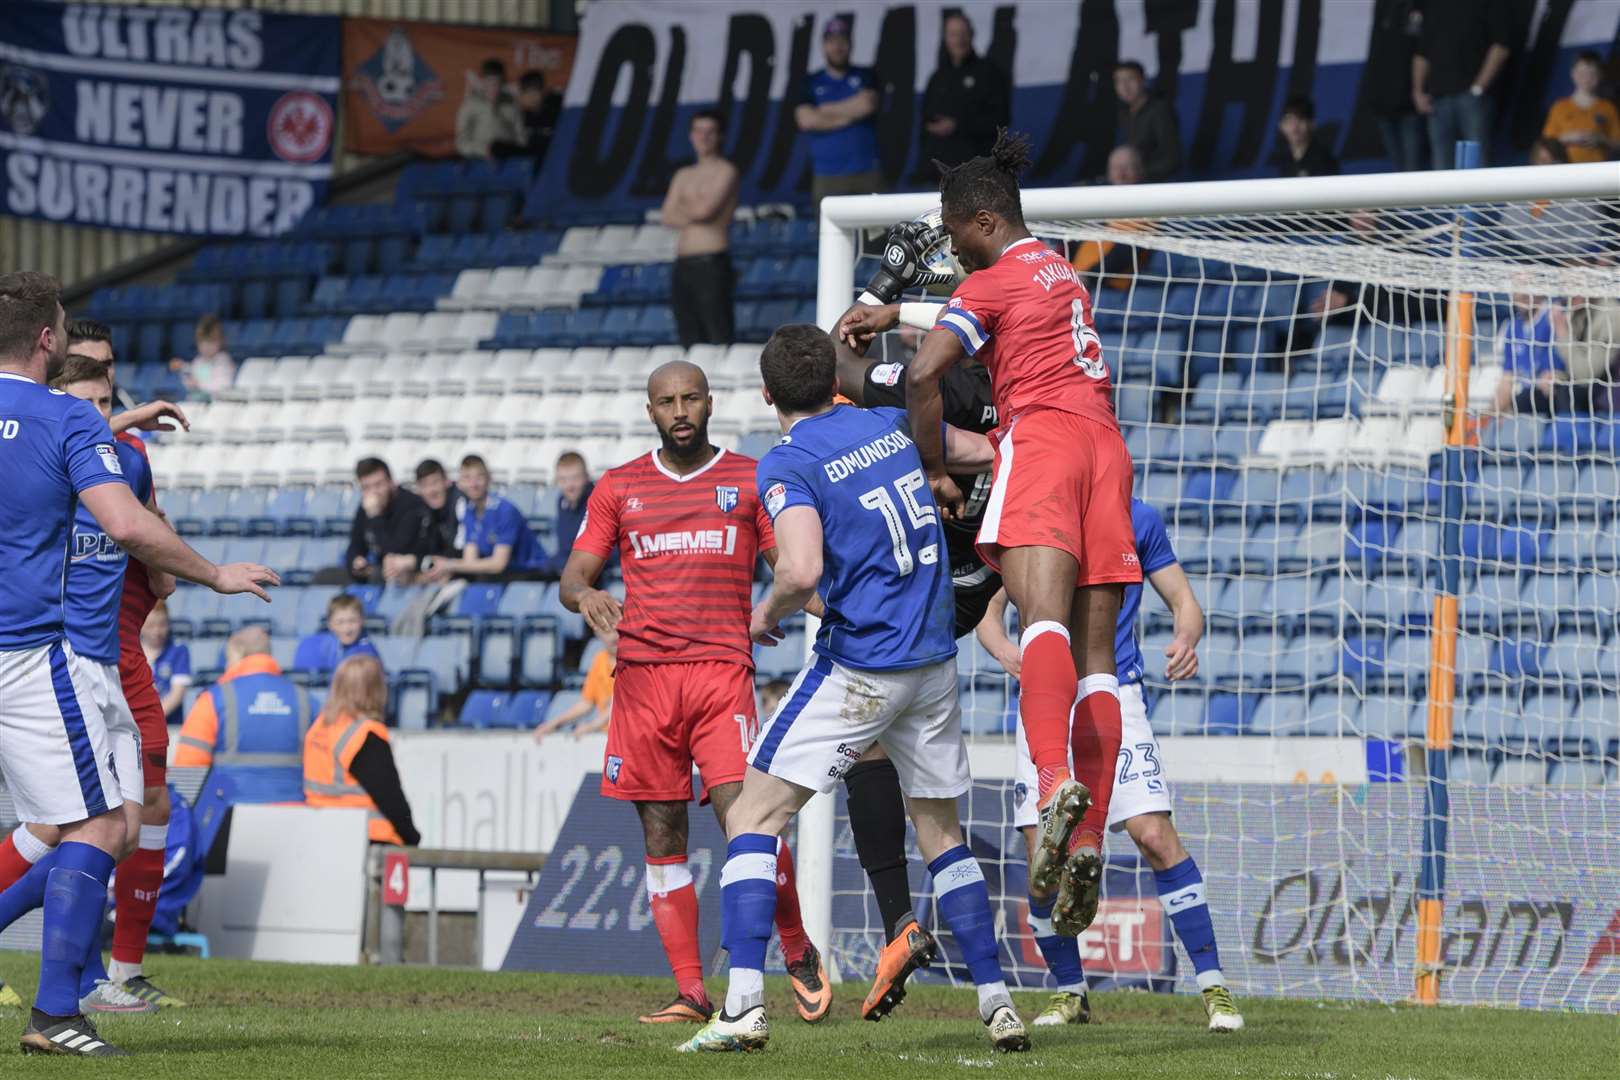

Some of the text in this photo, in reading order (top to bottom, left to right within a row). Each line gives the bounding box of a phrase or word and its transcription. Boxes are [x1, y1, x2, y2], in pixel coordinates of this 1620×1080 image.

[62, 6, 263, 69] ULTRAS
[75, 79, 244, 153] NEVER
[7, 153, 314, 237] SURRENDER
[1071, 298, 1108, 379] 6
[858, 468, 938, 577] 15
[1119, 743, 1160, 785] 23
[389, 863, 405, 897] 4
